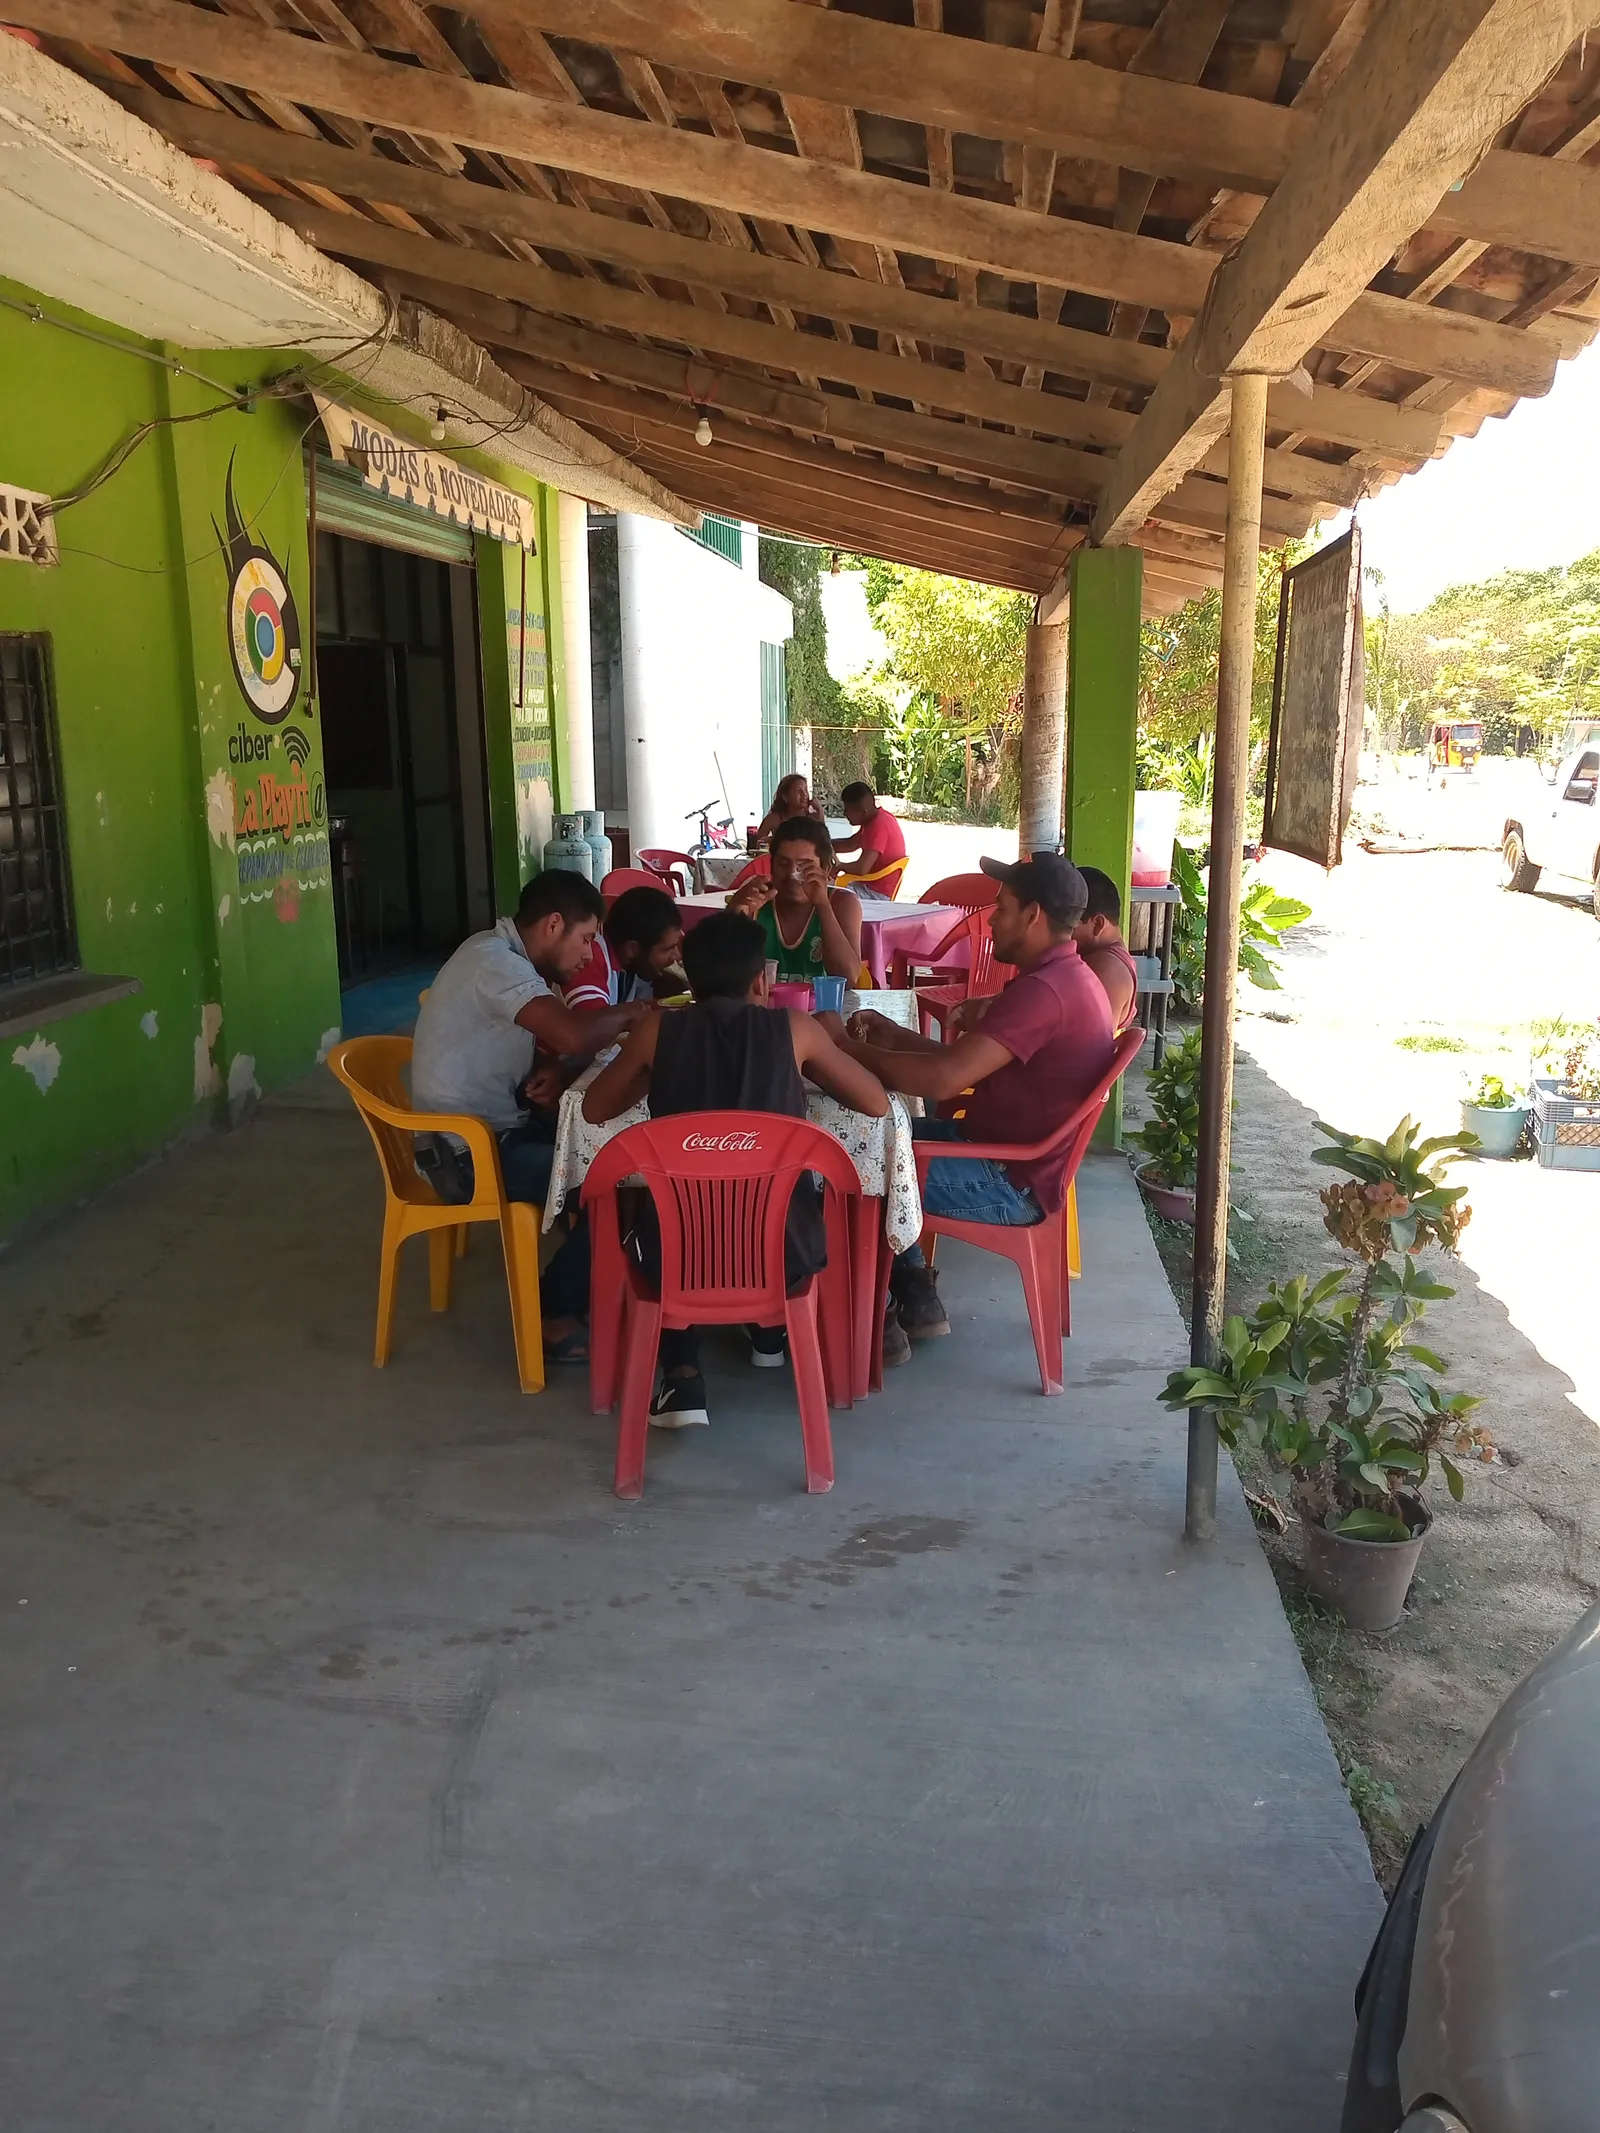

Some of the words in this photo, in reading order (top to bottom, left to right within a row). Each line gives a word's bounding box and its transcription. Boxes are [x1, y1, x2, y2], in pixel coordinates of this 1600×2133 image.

[351, 419, 420, 488] MODAS
[424, 457, 438, 496] &
[438, 464, 521, 530] NOVEDADES
[229, 722, 273, 763] ciber
[231, 778, 260, 839] La
[682, 1131, 761, 1152] Coca-Cola
